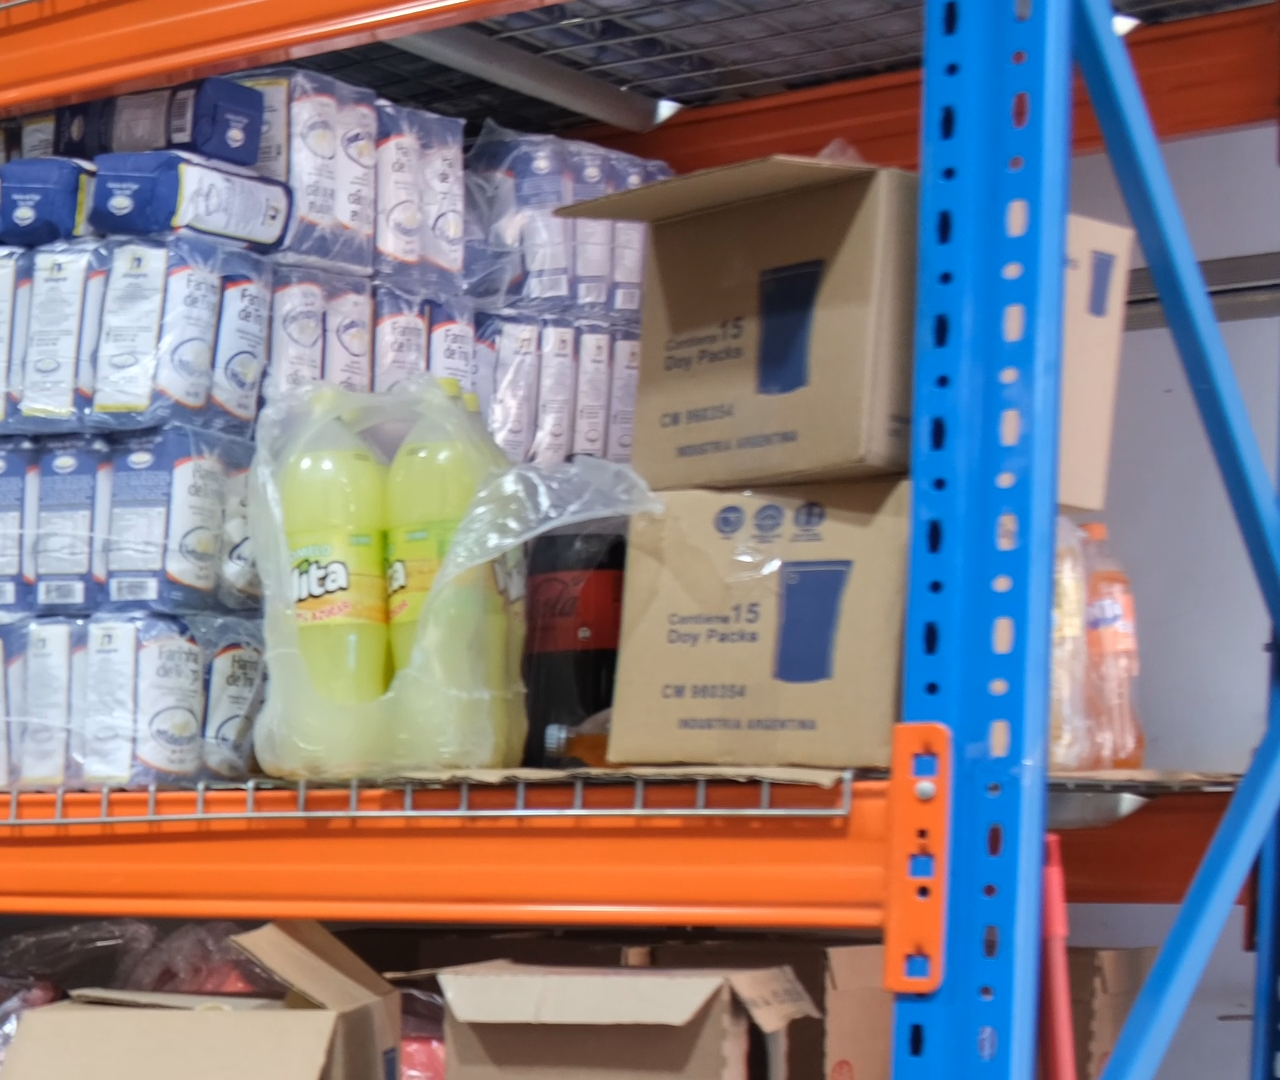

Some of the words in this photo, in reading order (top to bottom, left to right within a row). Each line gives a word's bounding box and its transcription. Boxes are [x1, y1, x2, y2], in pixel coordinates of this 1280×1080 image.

[665, 334, 719, 352] Contiene
[720, 315, 744, 341] 15
[664, 354, 694, 372] Doy
[697, 347, 744, 364] Packs
[668, 612, 731, 626] Contiene
[732, 602, 761, 624] 15
[667, 630, 701, 647] Doy
[706, 629, 759, 644] Packs
